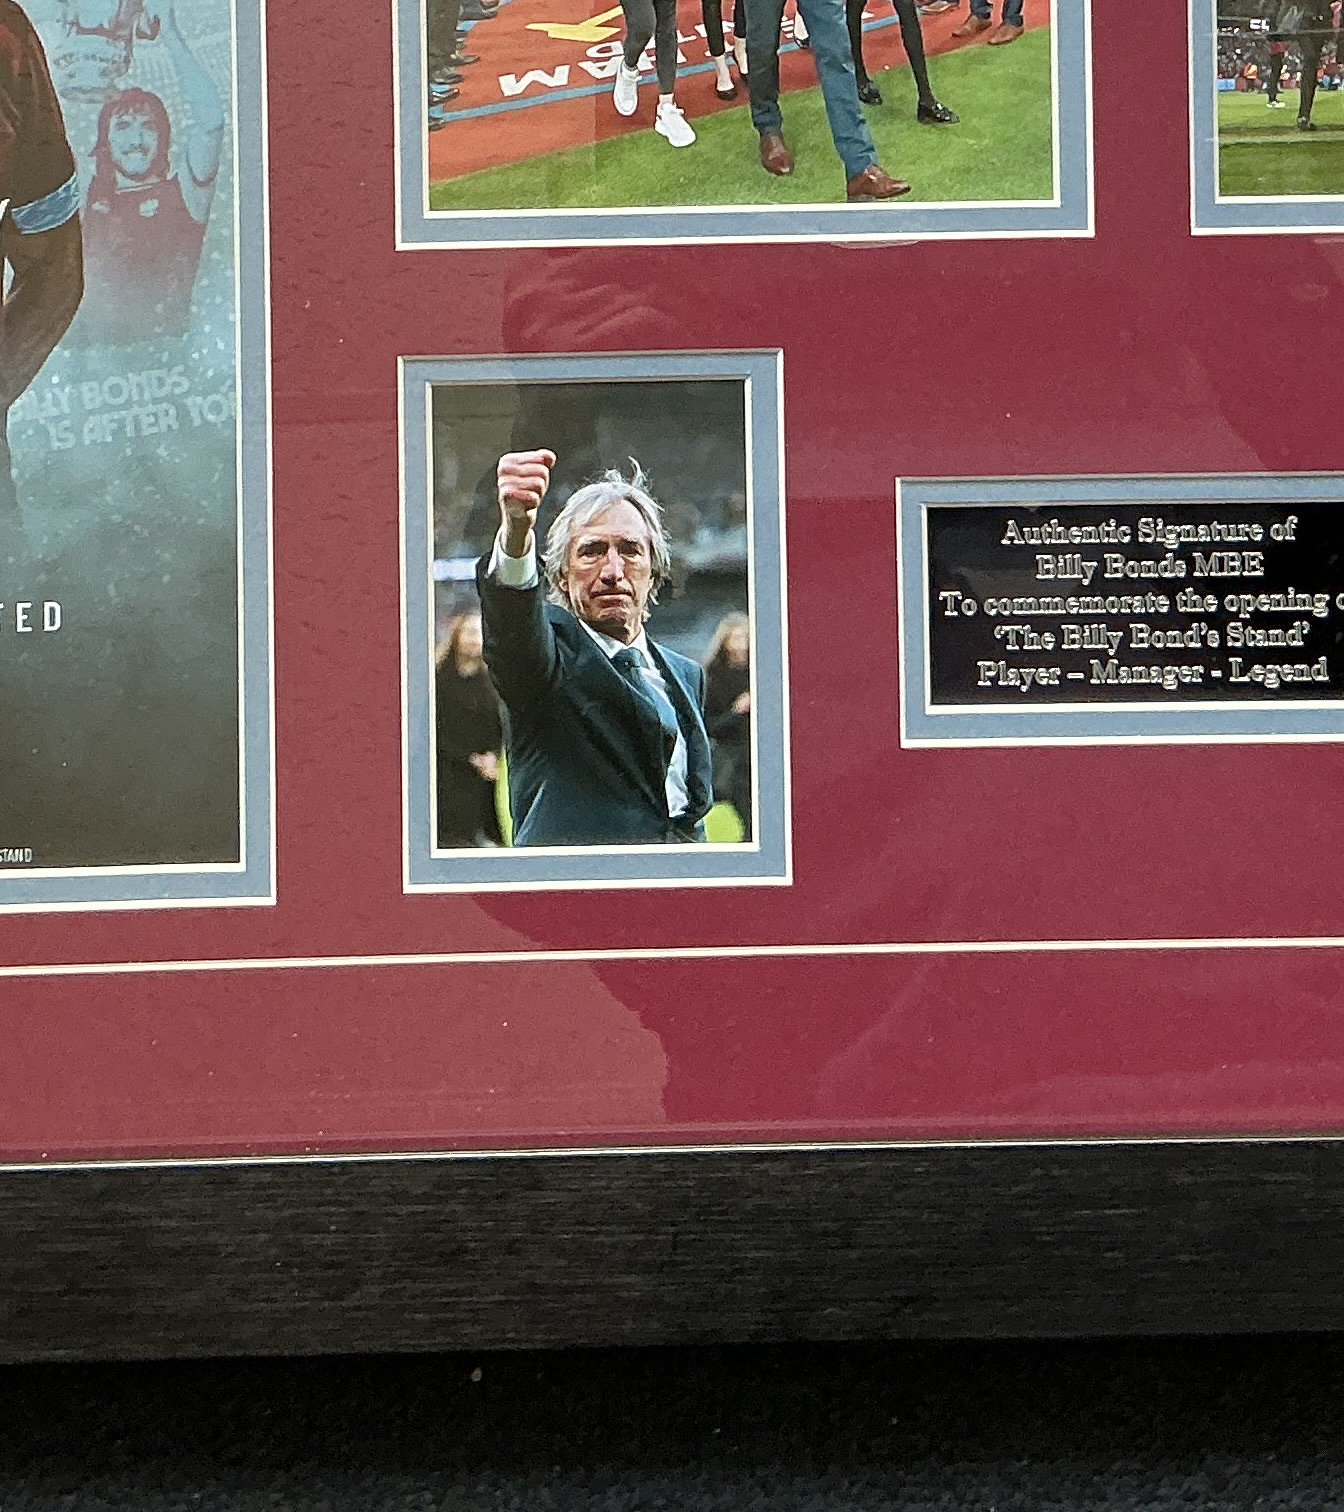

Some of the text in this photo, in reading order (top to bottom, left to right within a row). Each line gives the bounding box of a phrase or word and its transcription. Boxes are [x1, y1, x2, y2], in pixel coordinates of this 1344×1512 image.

[81, 364, 191, 411] BONDS
[83, 402, 180, 445] AFTER
[1000, 515, 1299, 550] Authentic Signature of
[1034, 551, 1265, 585] Billy Bonds MBE
[938, 590, 977, 617] To
[983, 590, 1170, 616] commemorate
[1176, 587, 1218, 614] the
[1224, 587, 1331, 619] opening
[1061, 622, 1124, 655] Billy
[976, 660, 1061, 693] Player
[1089, 658, 1205, 691] Manager
[1228, 656, 1330, 689] Legend
